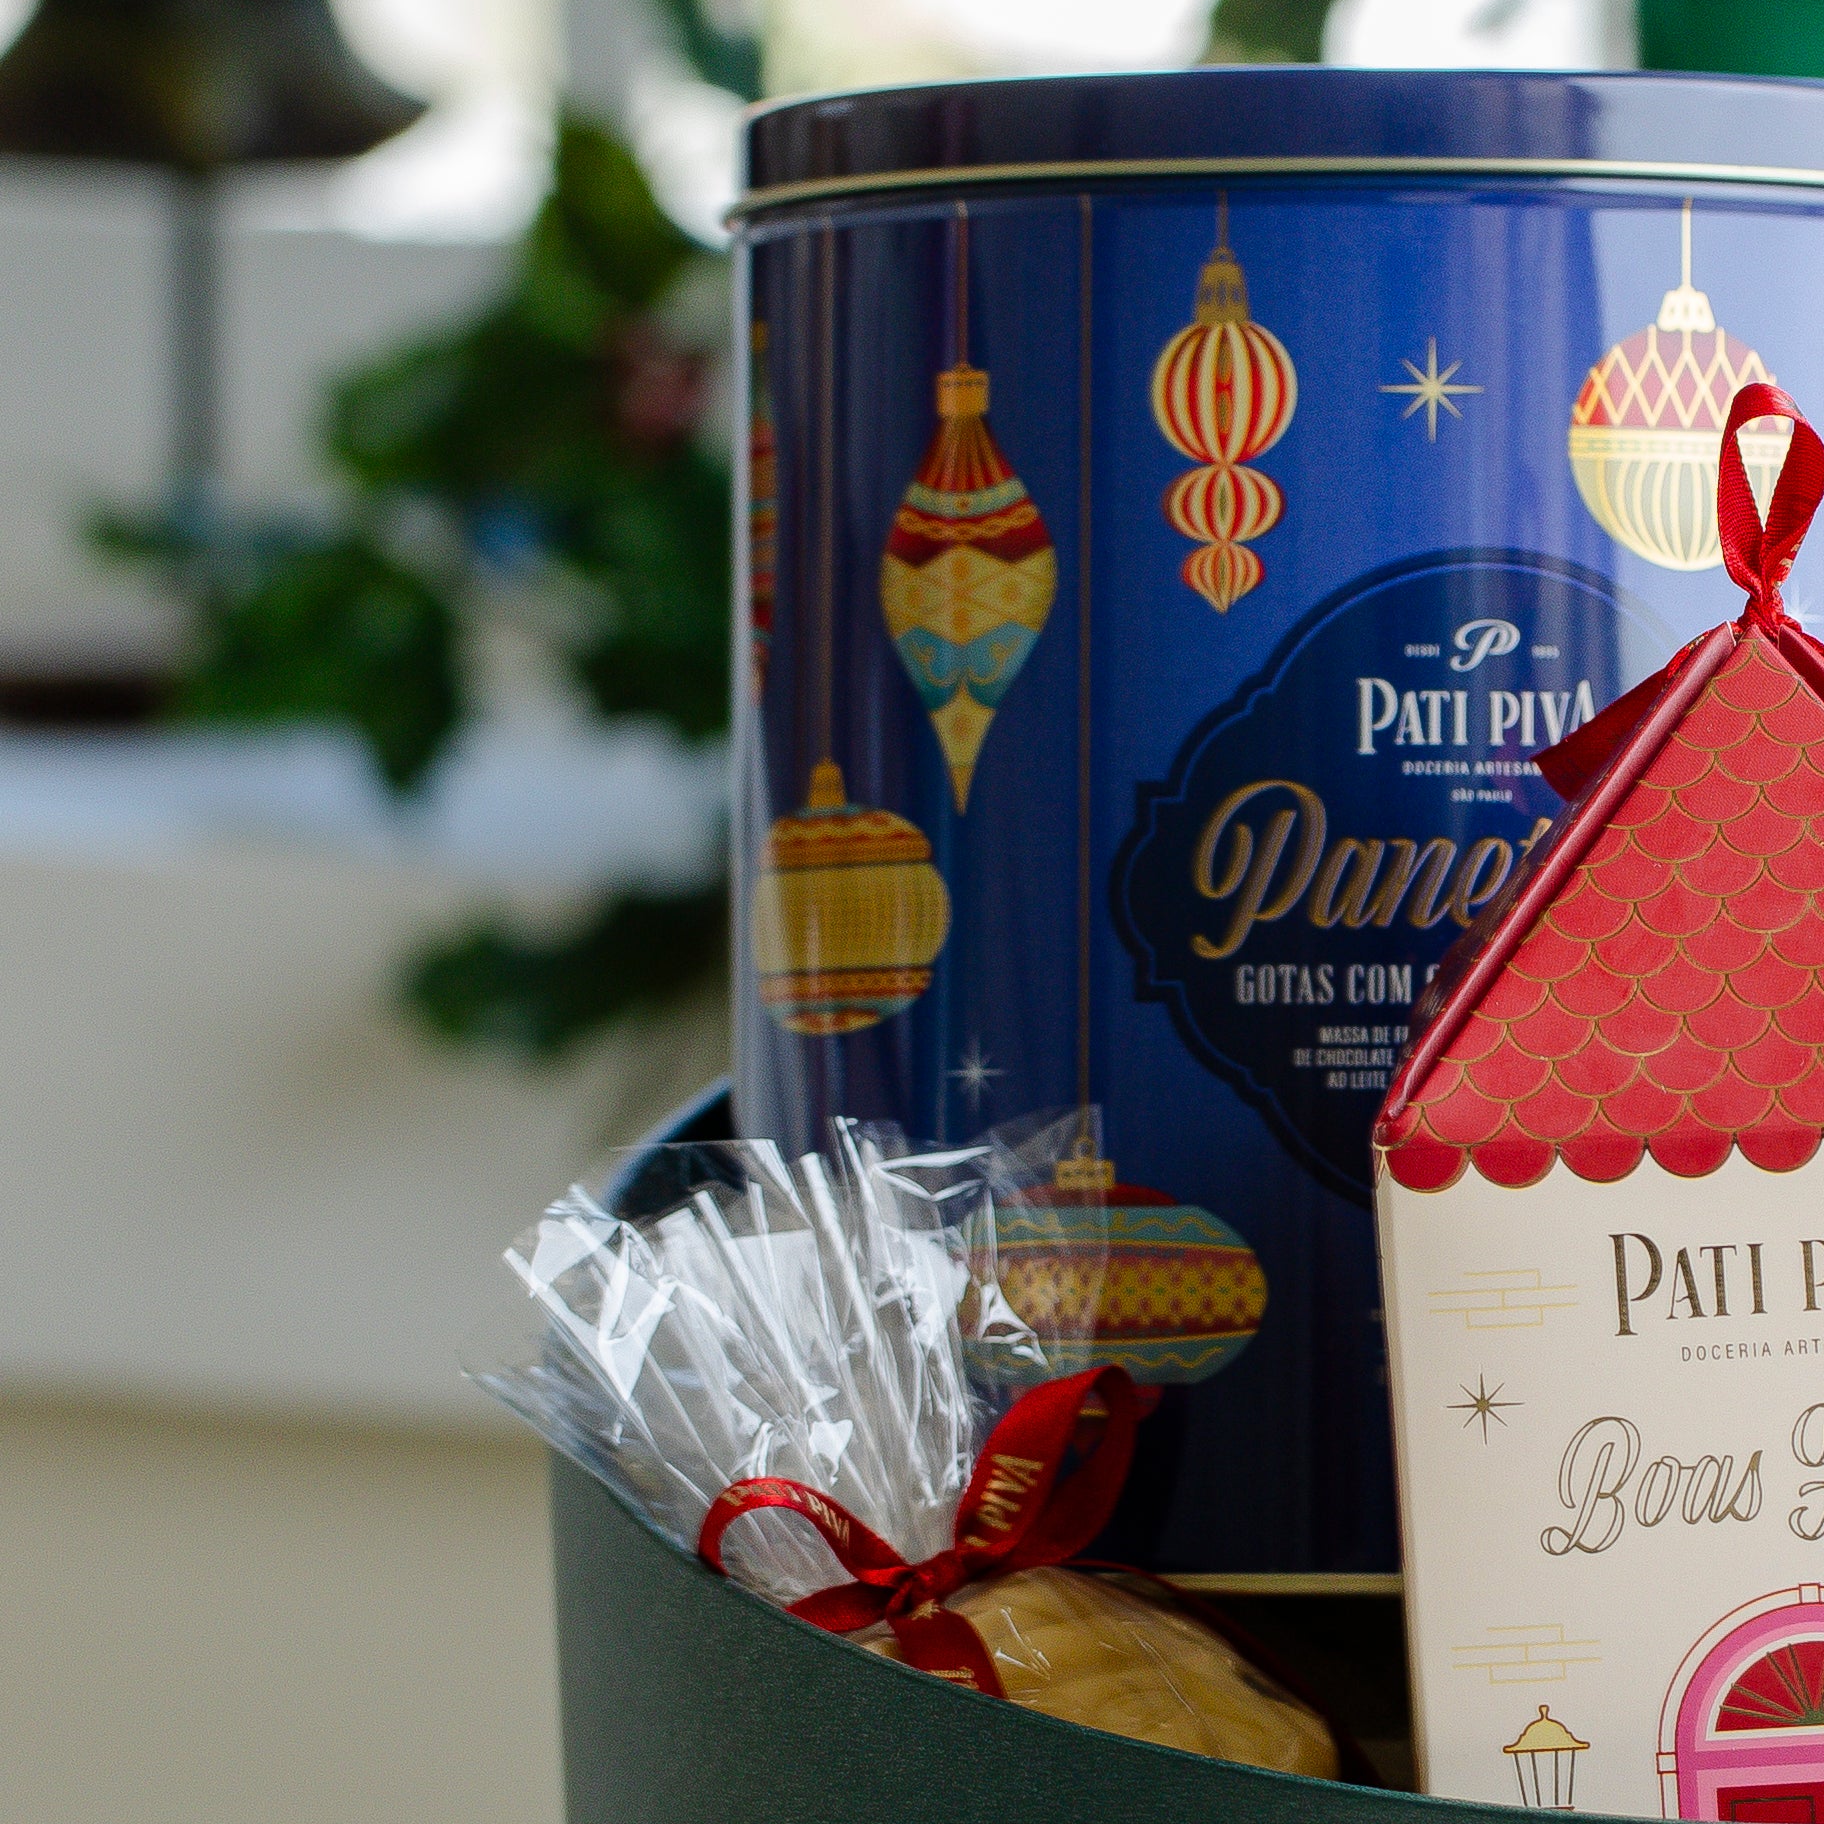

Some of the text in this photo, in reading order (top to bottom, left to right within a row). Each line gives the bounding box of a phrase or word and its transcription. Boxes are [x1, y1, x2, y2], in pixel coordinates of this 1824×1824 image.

[1356, 677, 1597, 755] PATI PIVA
[1234, 963, 1335, 1005] GOTAS
[1347, 963, 1413, 1005] COM
[1608, 1233, 1765, 1337] PATI
[1681, 1340, 1772, 1363] DOCERIA
[1540, 1416, 1764, 1557] Boas
